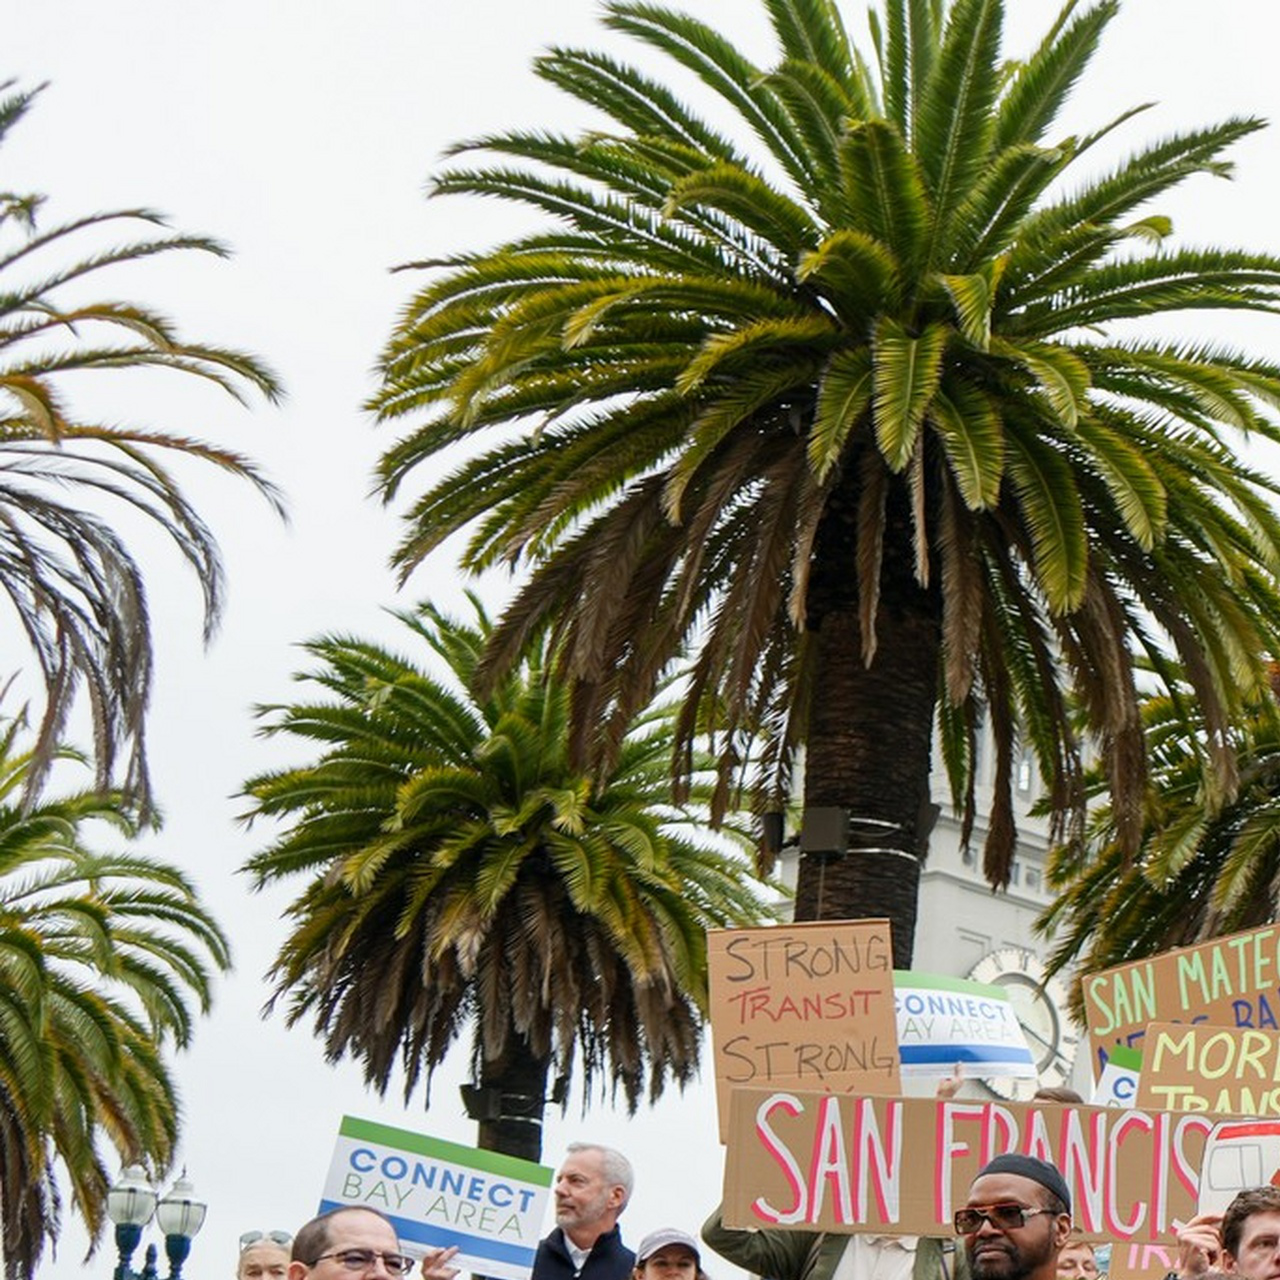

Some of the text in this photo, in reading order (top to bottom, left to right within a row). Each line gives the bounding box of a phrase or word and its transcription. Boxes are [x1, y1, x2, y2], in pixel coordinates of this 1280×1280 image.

[725, 935, 890, 982] STRONG
[728, 986, 882, 1025] TRANSIT
[893, 993, 1009, 1023] ONNECT
[1089, 963, 1157, 1036] SAN
[901, 1018, 934, 1041] AY
[722, 1036, 896, 1084] STRONG
[349, 1147, 536, 1215] CONNECT
[750, 1092, 903, 1226] SAN
[341, 1172, 524, 1240] BAY AREA
